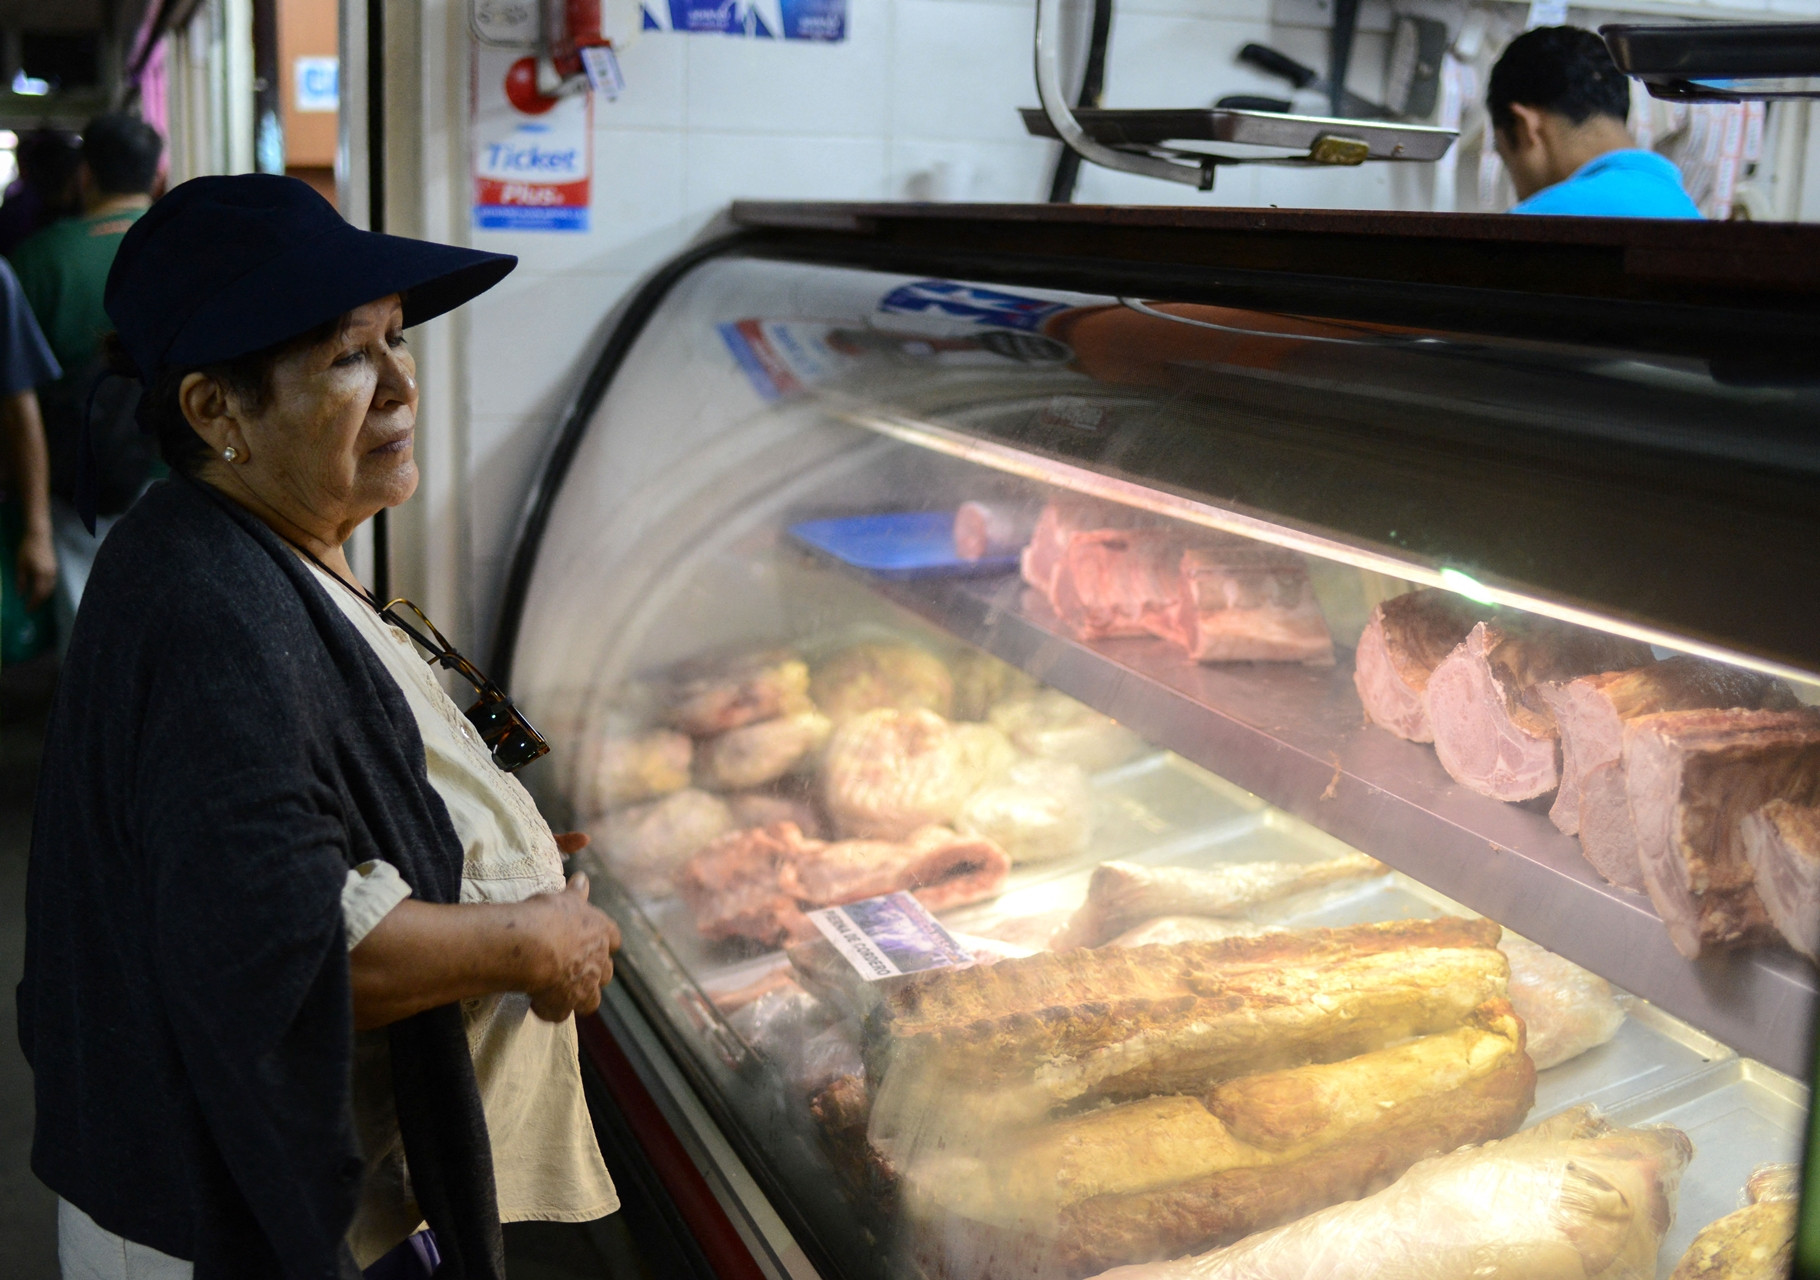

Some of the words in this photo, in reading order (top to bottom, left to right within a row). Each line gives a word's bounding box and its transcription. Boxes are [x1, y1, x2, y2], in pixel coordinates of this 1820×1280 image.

[487, 143, 577, 172] Ticket
[844, 933, 862, 944] DE
[854, 943, 890, 975] CORDERO
